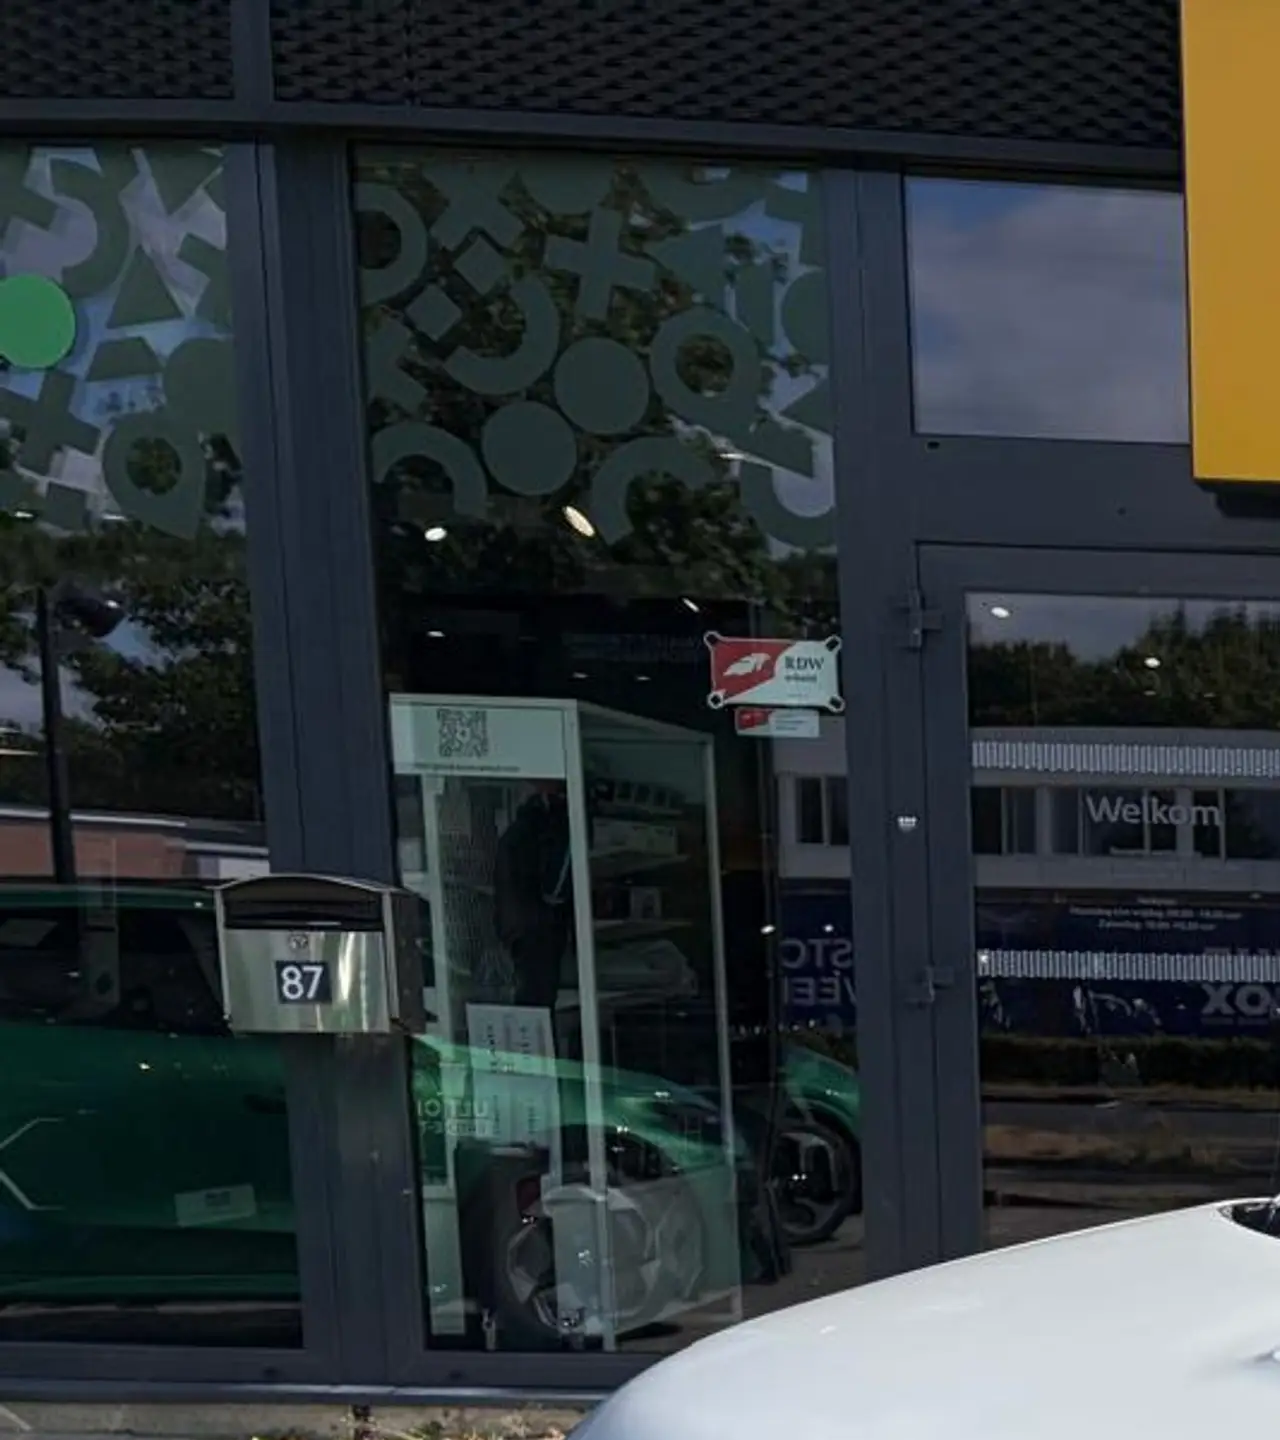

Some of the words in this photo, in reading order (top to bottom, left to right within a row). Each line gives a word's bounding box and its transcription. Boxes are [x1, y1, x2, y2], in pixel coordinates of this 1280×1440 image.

[785, 655, 825, 670] RDW
[1086, 795, 1221, 826] Welkom
[281, 965, 323, 999] 87
